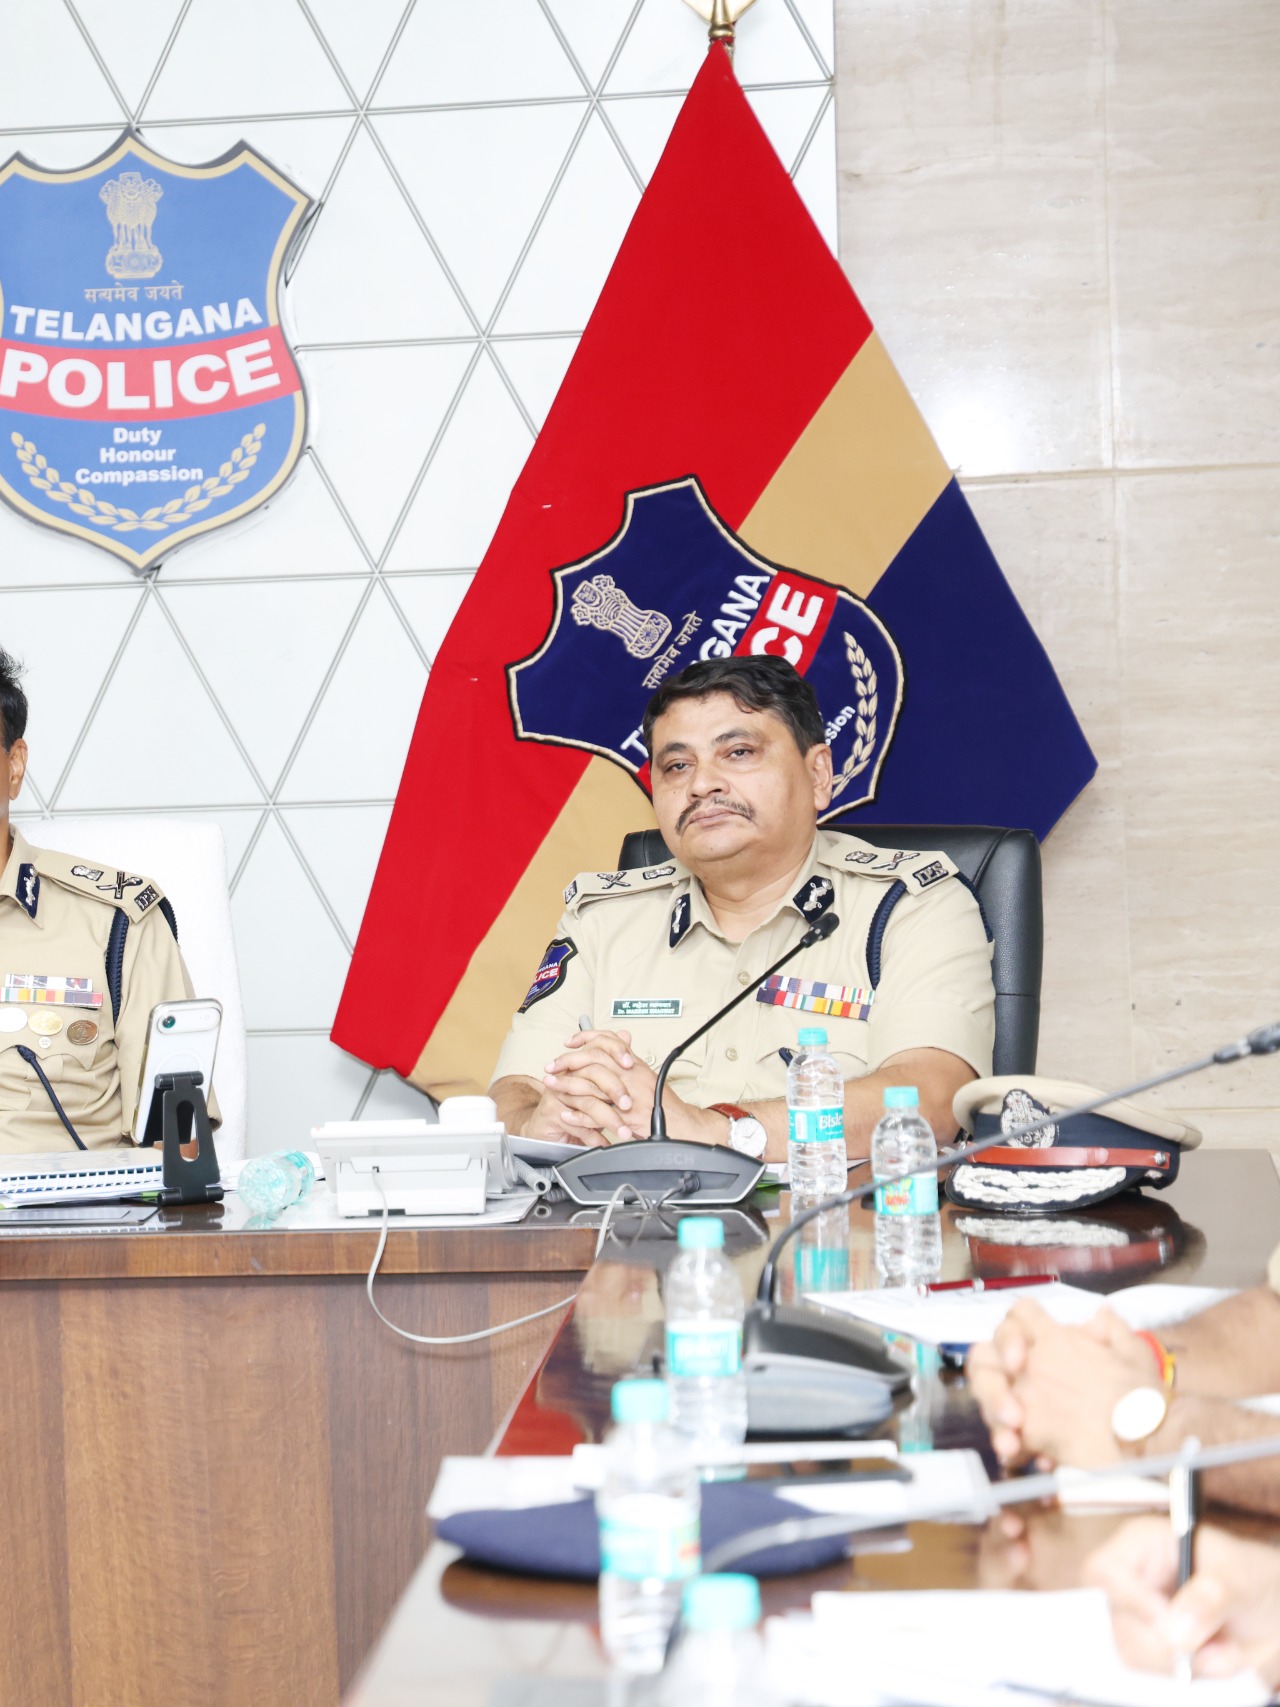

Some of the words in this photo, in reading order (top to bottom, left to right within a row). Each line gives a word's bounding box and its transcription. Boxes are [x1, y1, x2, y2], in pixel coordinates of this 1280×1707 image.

[84, 282, 139, 303] सत्यमेव
[144, 280, 185, 302] जयते
[10, 297, 263, 342] TELANGANA
[113, 427, 163, 446] Duty
[99, 447, 177, 464] Honour
[75, 465, 204, 486] Compassion
[641, 643, 682, 689] सत्यमेव
[674, 610, 703, 645] जयते
